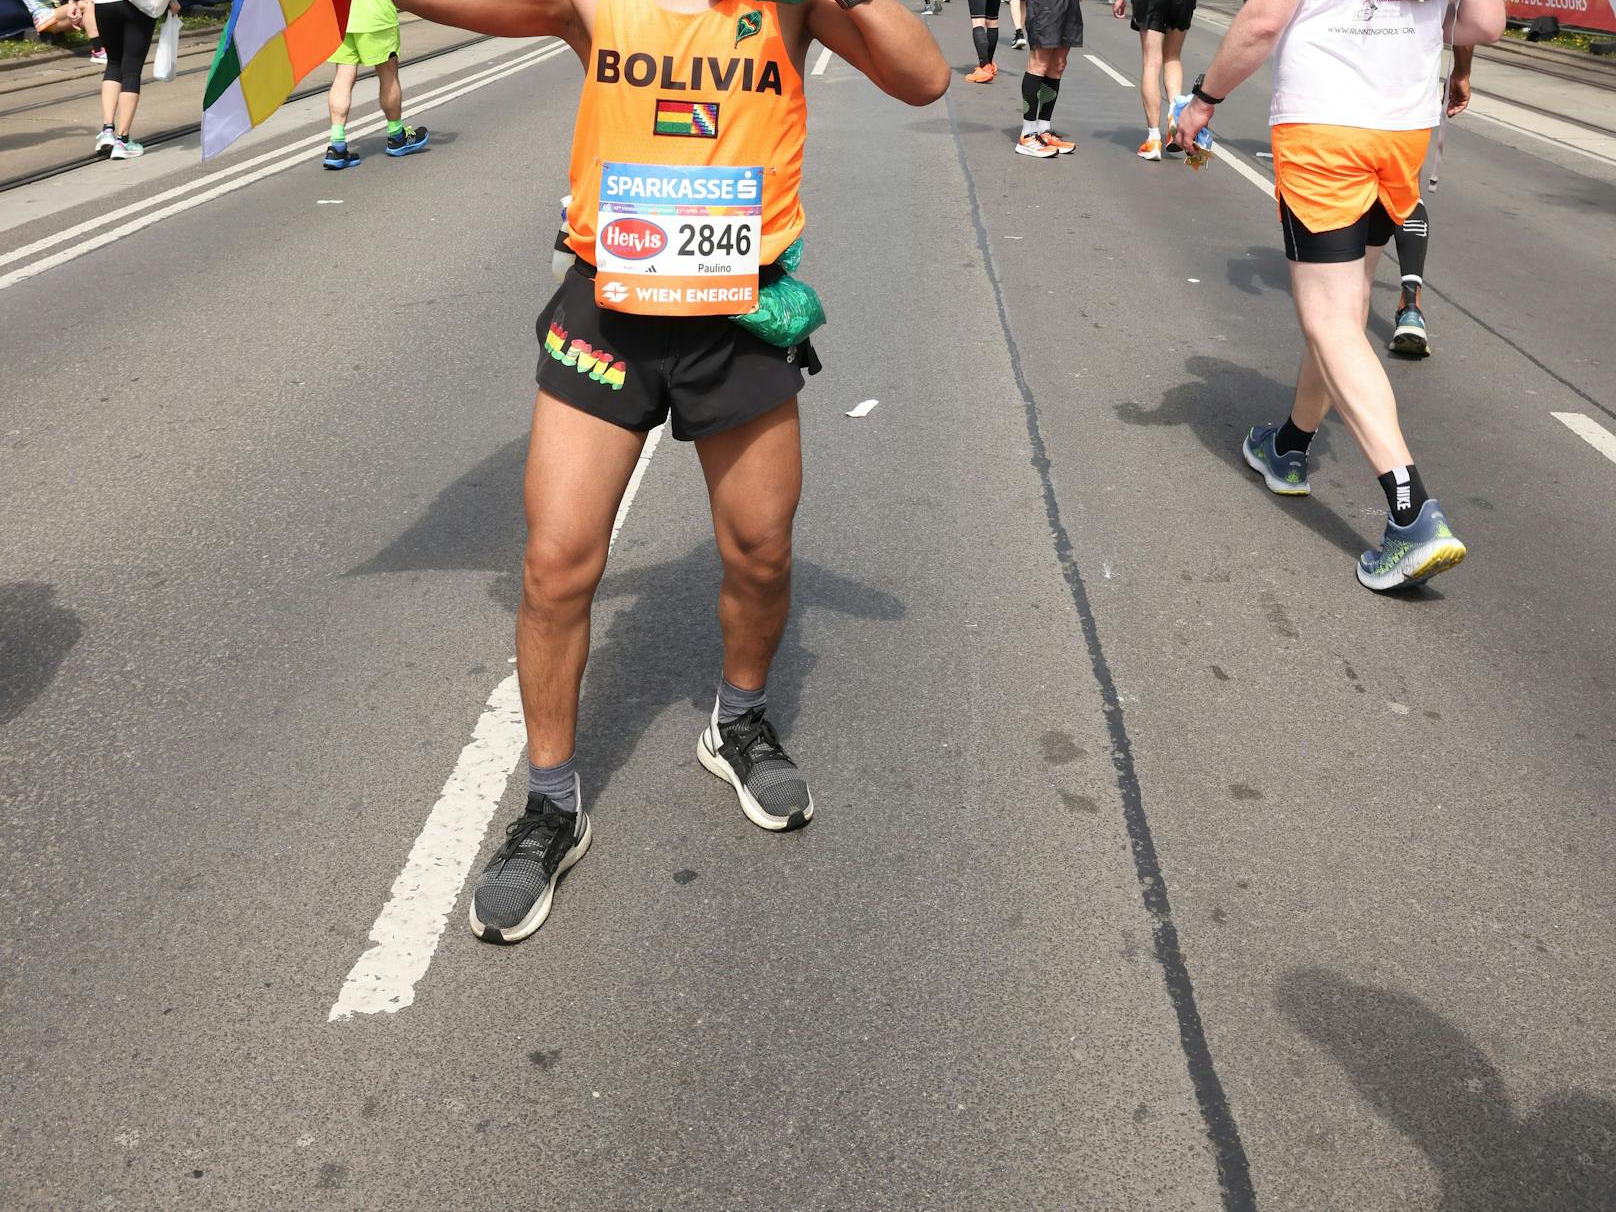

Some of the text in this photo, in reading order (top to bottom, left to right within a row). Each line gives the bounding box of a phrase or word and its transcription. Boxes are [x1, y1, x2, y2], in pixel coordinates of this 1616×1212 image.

[596, 49, 782, 96] BOLIVIA
[606, 175, 734, 199] SPARKASSE
[606, 226, 662, 252] Hervis
[677, 223, 751, 257] 2846
[697, 263, 732, 273] Paulino
[635, 287, 753, 303] WIEN ENERGIE
[1396, 485, 1411, 511] NIKE
